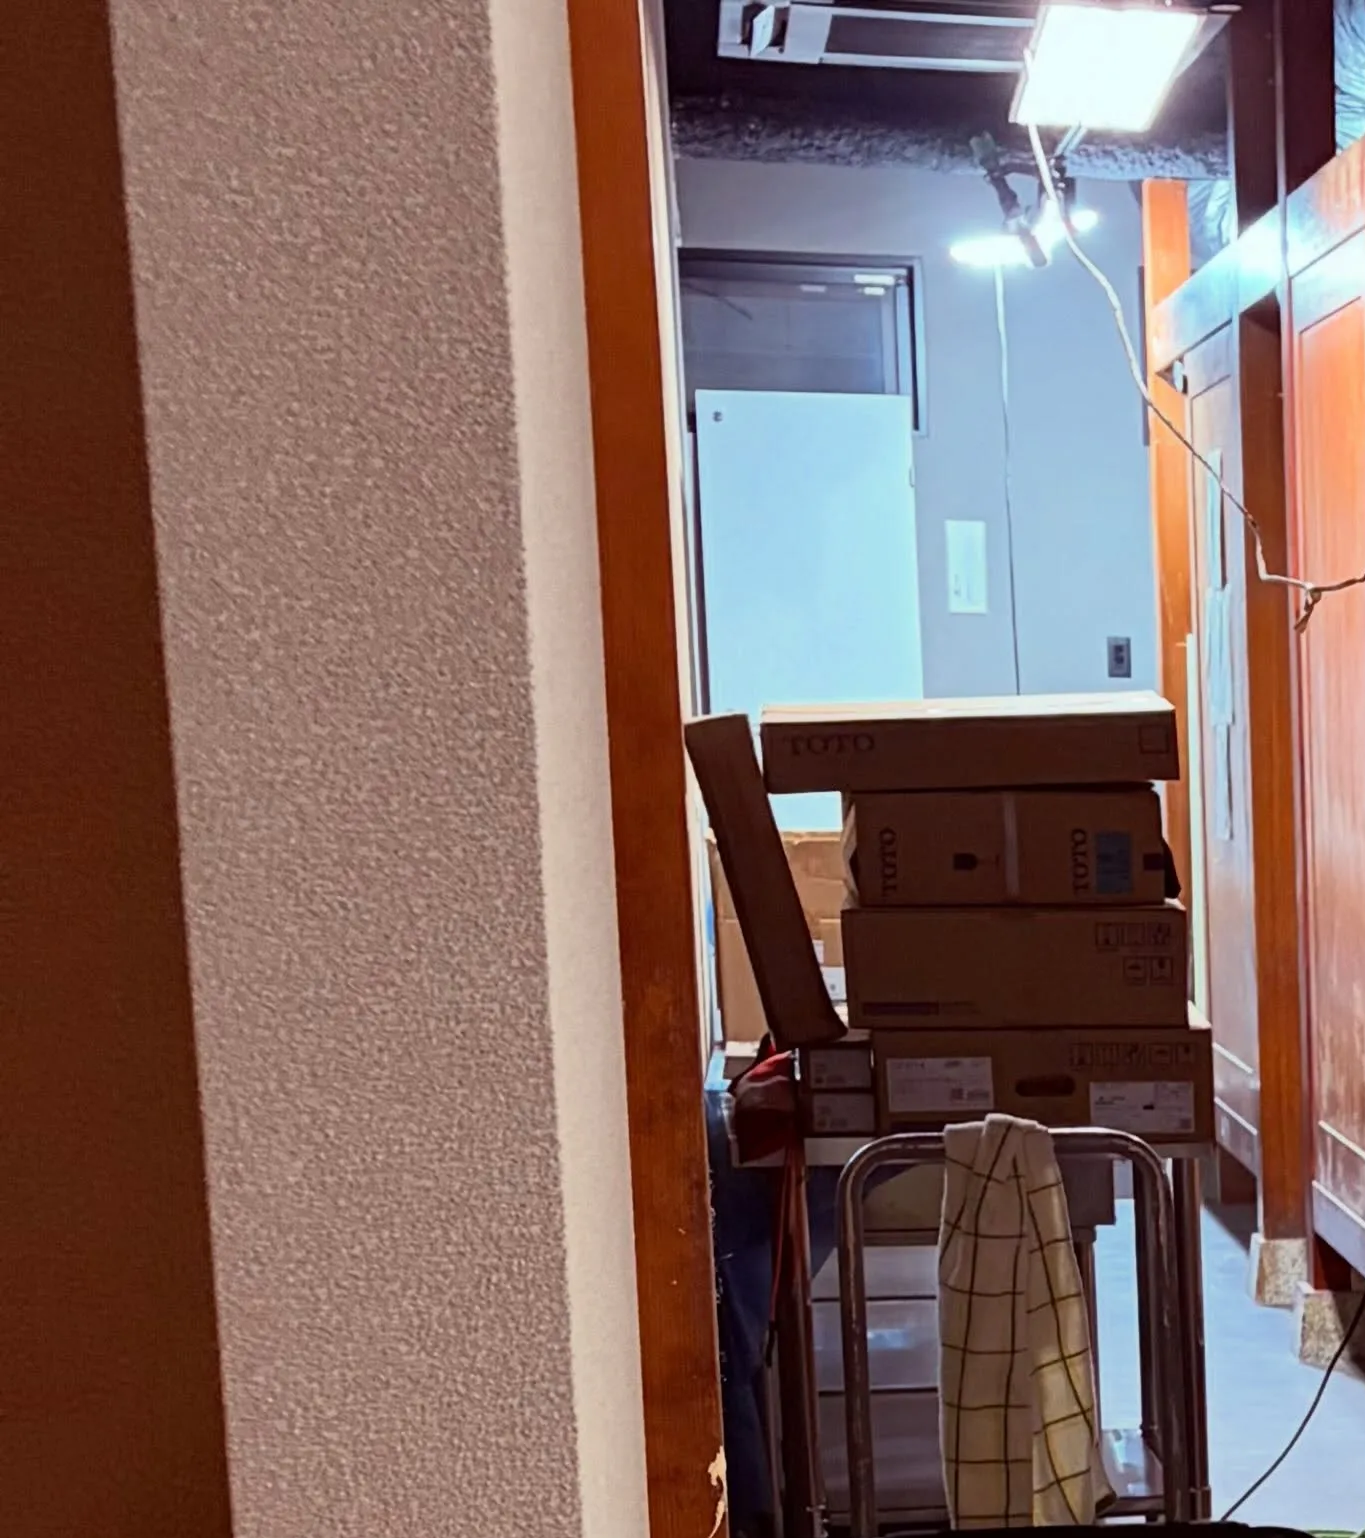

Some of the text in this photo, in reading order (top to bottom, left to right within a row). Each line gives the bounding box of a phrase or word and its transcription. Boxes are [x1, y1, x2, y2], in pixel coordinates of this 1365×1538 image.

[786, 732, 876, 757] TOTO
[880, 827, 899, 895] TOTO
[1072, 828, 1091, 893] TOTO
